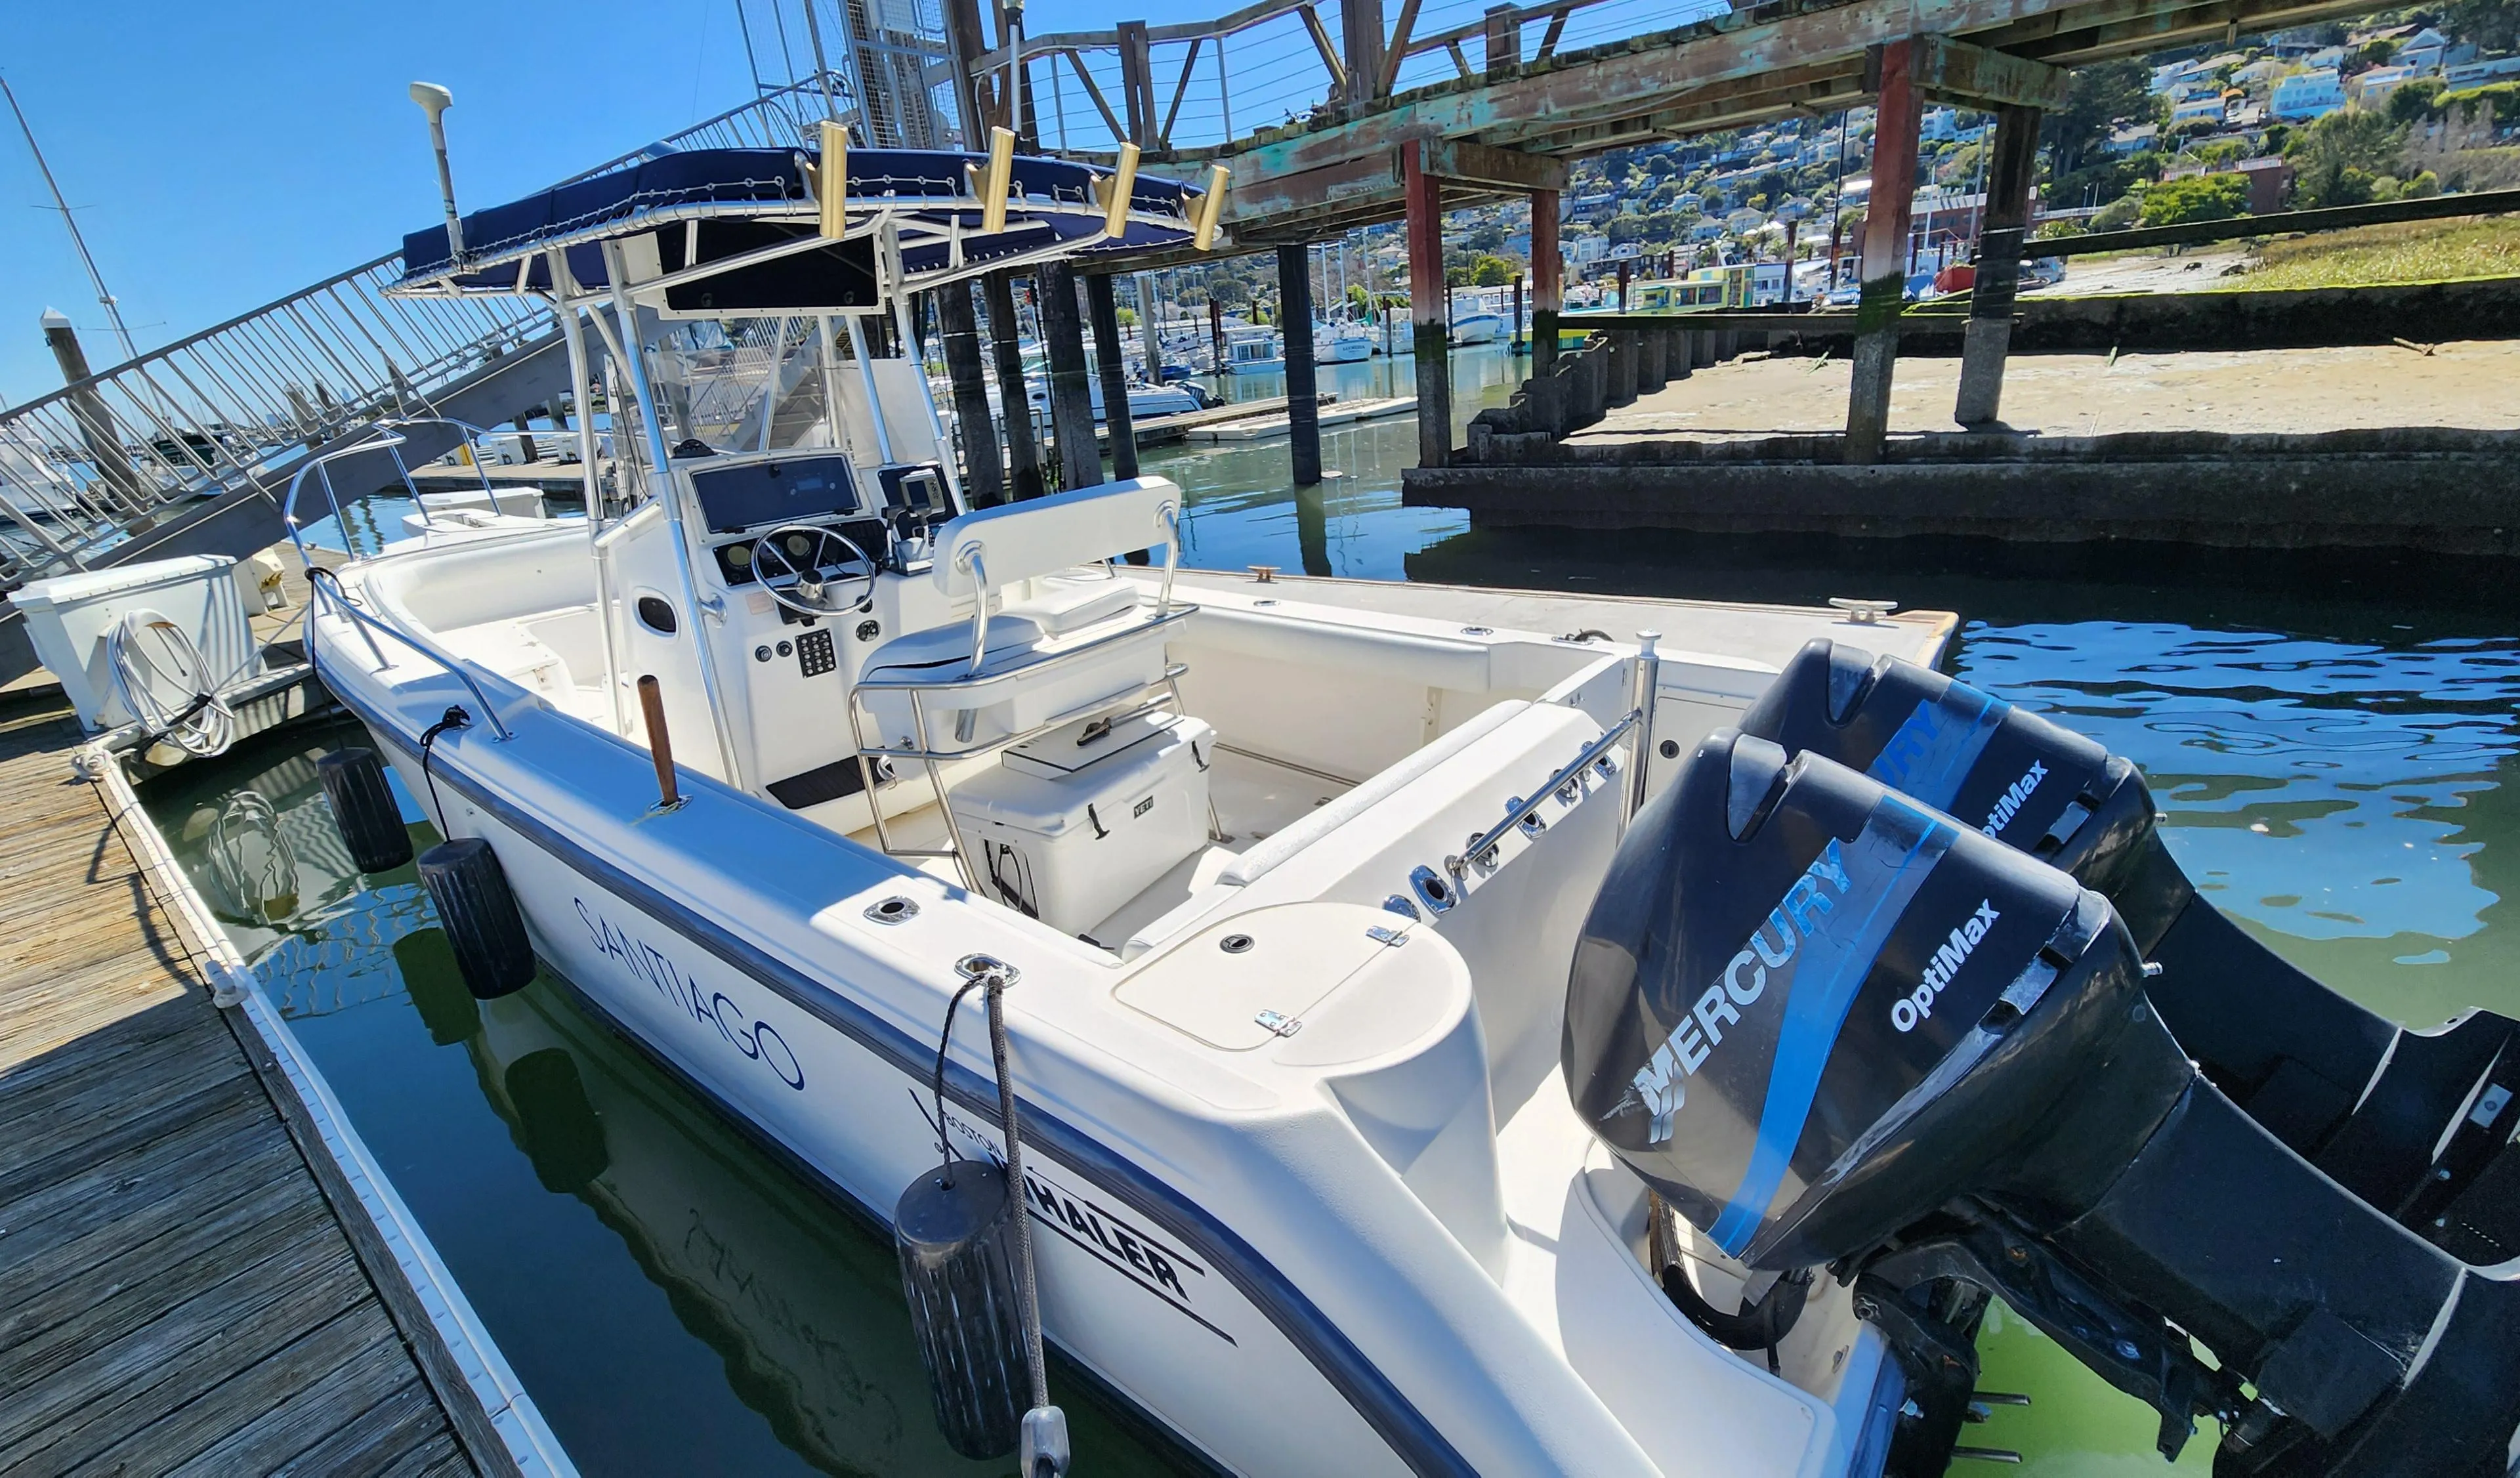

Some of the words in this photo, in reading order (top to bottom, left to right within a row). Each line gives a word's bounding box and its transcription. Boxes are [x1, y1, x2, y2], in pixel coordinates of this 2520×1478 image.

[1135, 798, 1152, 815] YETI
[1982, 759, 2049, 839] ptiMax
[574, 897, 805, 1091] SANTIAGO
[1633, 837, 1851, 1116] MERCURY
[1891, 898, 2000, 1032] OptiMax
[943, 1110, 1005, 1160] BOSTON
